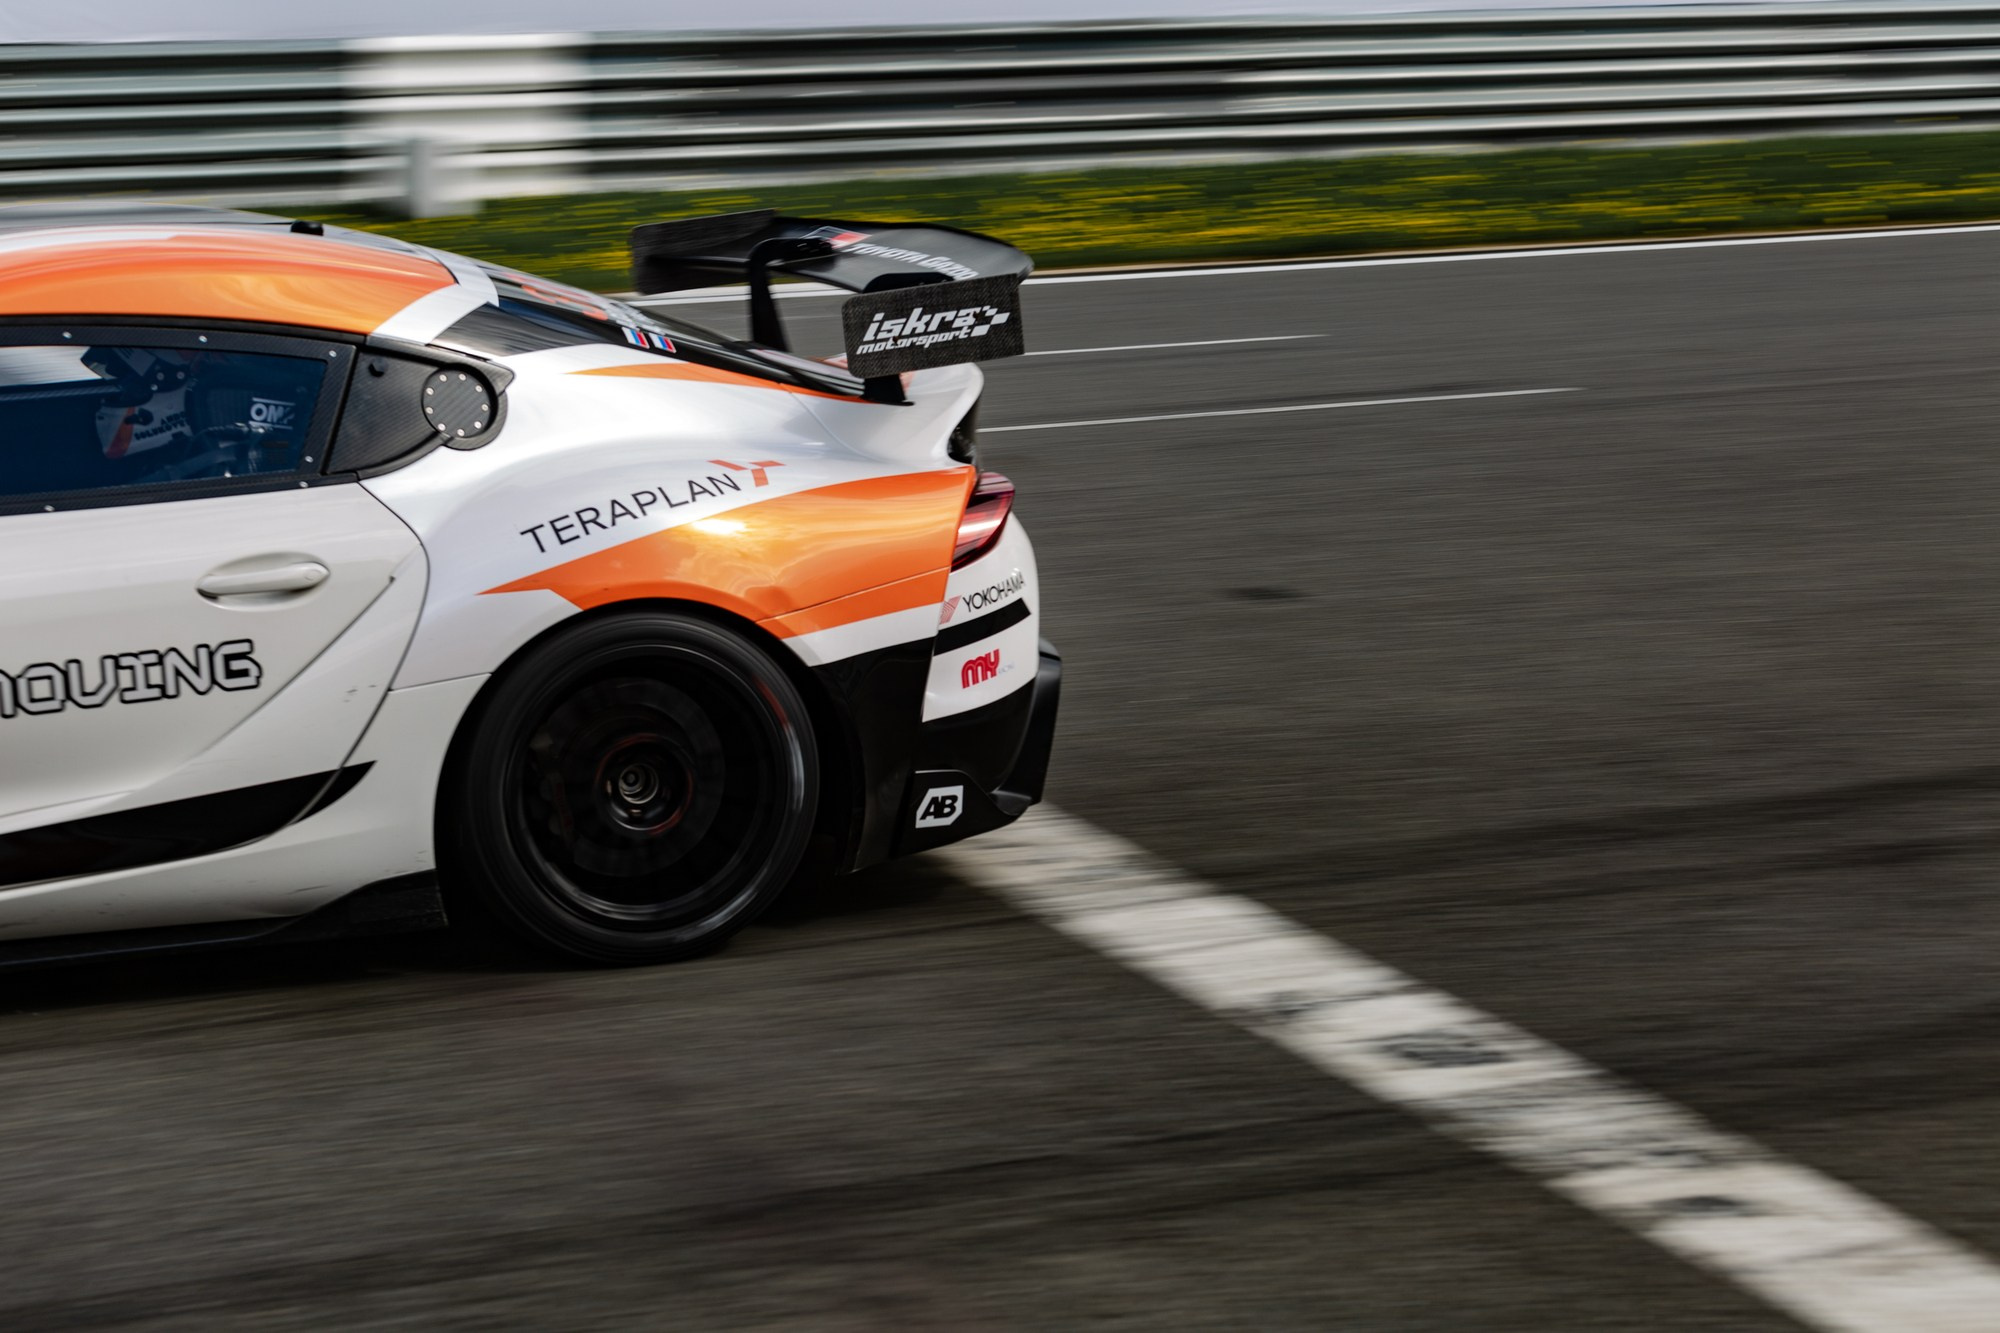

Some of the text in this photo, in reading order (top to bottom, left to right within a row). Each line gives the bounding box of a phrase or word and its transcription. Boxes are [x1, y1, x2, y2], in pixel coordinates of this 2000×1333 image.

[862, 306, 983, 342] iskra
[856, 326, 972, 355] motorsport
[962, 571, 1026, 613] YOKOHAMA
[918, 793, 959, 821] AB
